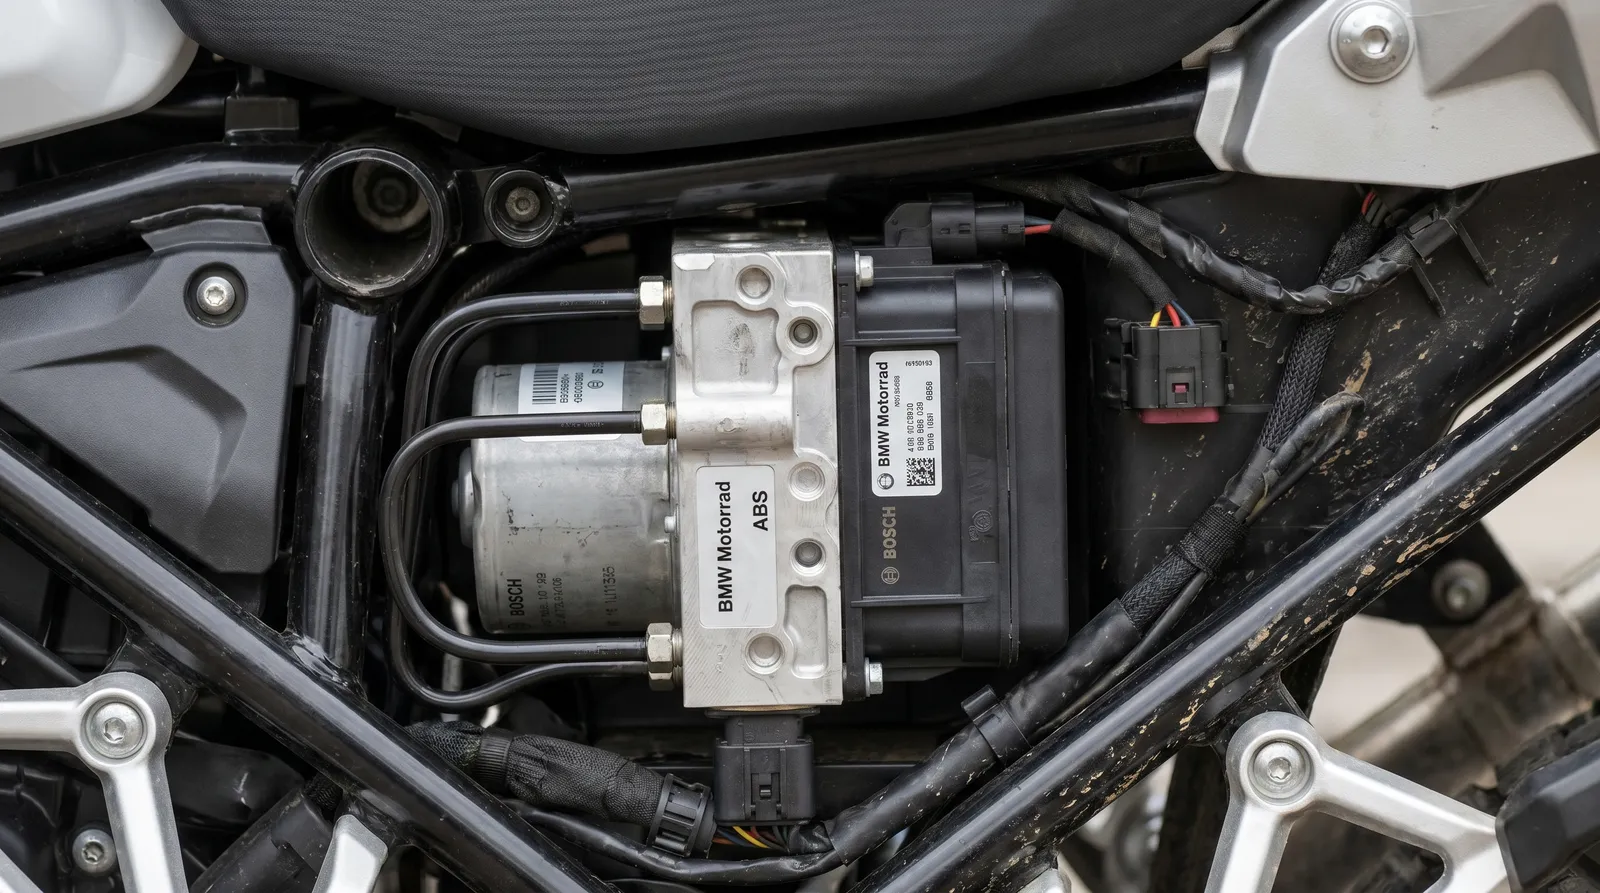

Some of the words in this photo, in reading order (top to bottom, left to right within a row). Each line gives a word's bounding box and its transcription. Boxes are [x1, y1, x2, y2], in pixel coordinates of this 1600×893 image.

[876, 361, 890, 427] Motorrad
[877, 430, 890, 467] BMW
[715, 481, 732, 562] Motorrad
[752, 490, 769, 532] ABS
[882, 506, 897, 559] BOSCH
[506, 578, 525, 617] BOSCH
[717, 566, 733, 613] BMW
